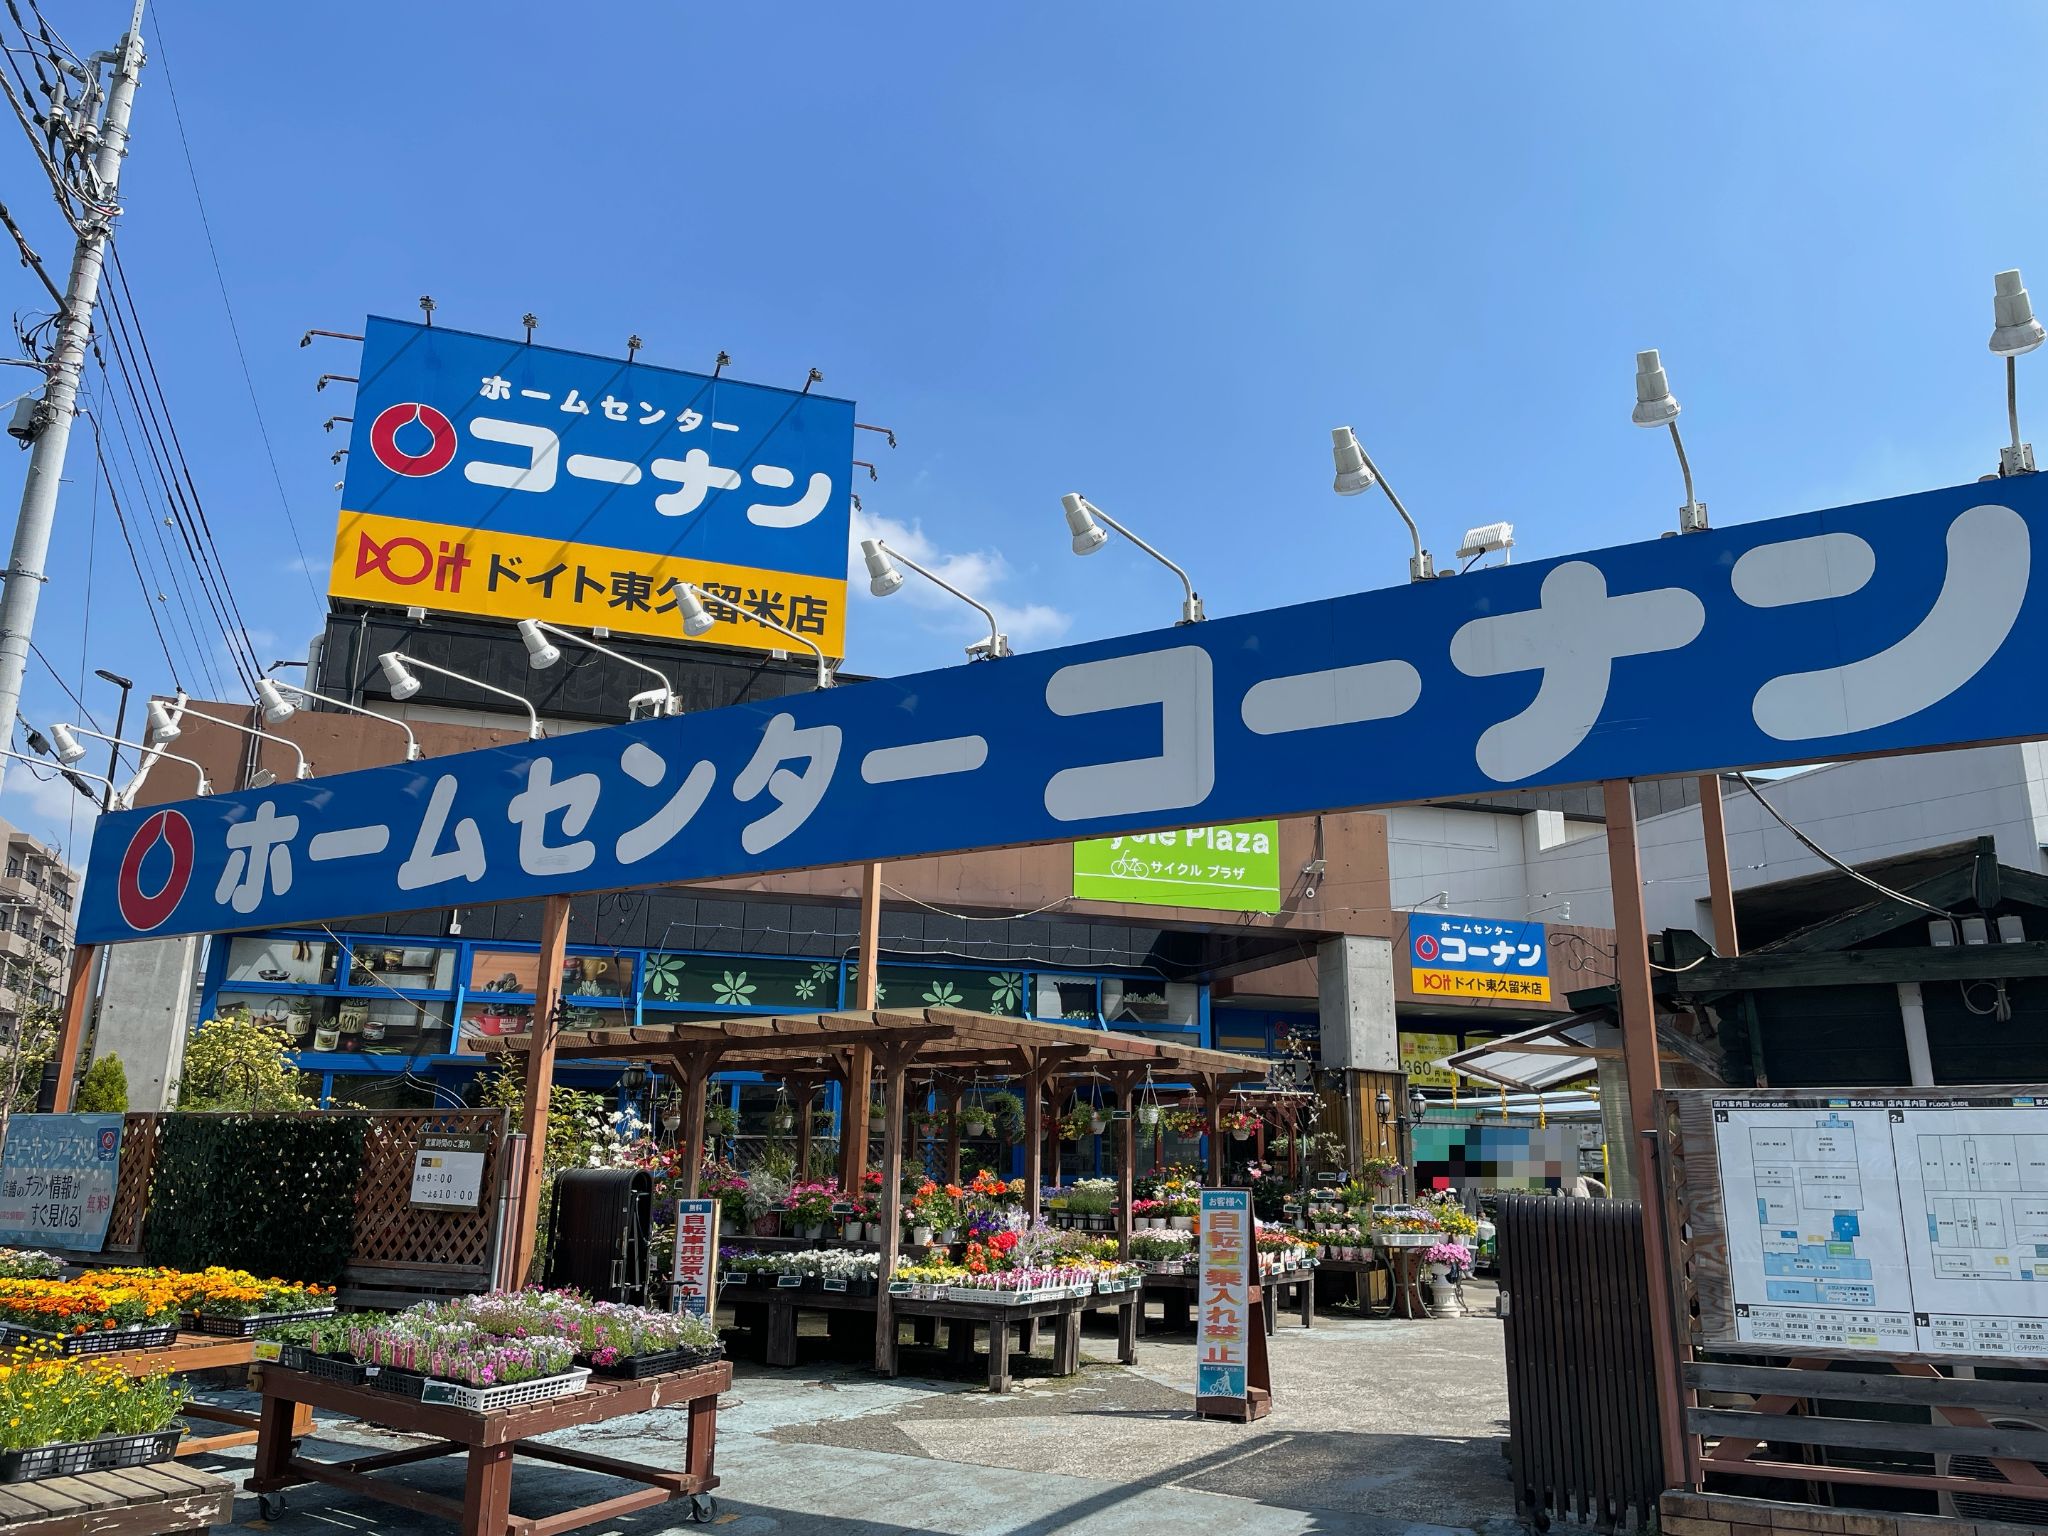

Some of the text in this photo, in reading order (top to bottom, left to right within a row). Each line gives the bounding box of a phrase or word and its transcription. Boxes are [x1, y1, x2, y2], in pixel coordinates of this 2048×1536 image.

[479, 375, 741, 433] ホームセンター
[464, 416, 833, 529] コーナン
[214, 504, 2031, 914] ホームセンター コーナン
[1151, 861, 1246, 880] サイクル プラザ
[1441, 922, 1514, 935] ホームセンター
[1441, 937, 1542, 967] コーナン
[1455, 977, 1542, 995] ドイト東久留米店
[1208, 1196, 1244, 1207] お客様へ
[1202, 1212, 1244, 1364] 自転車乗入れ禁止
